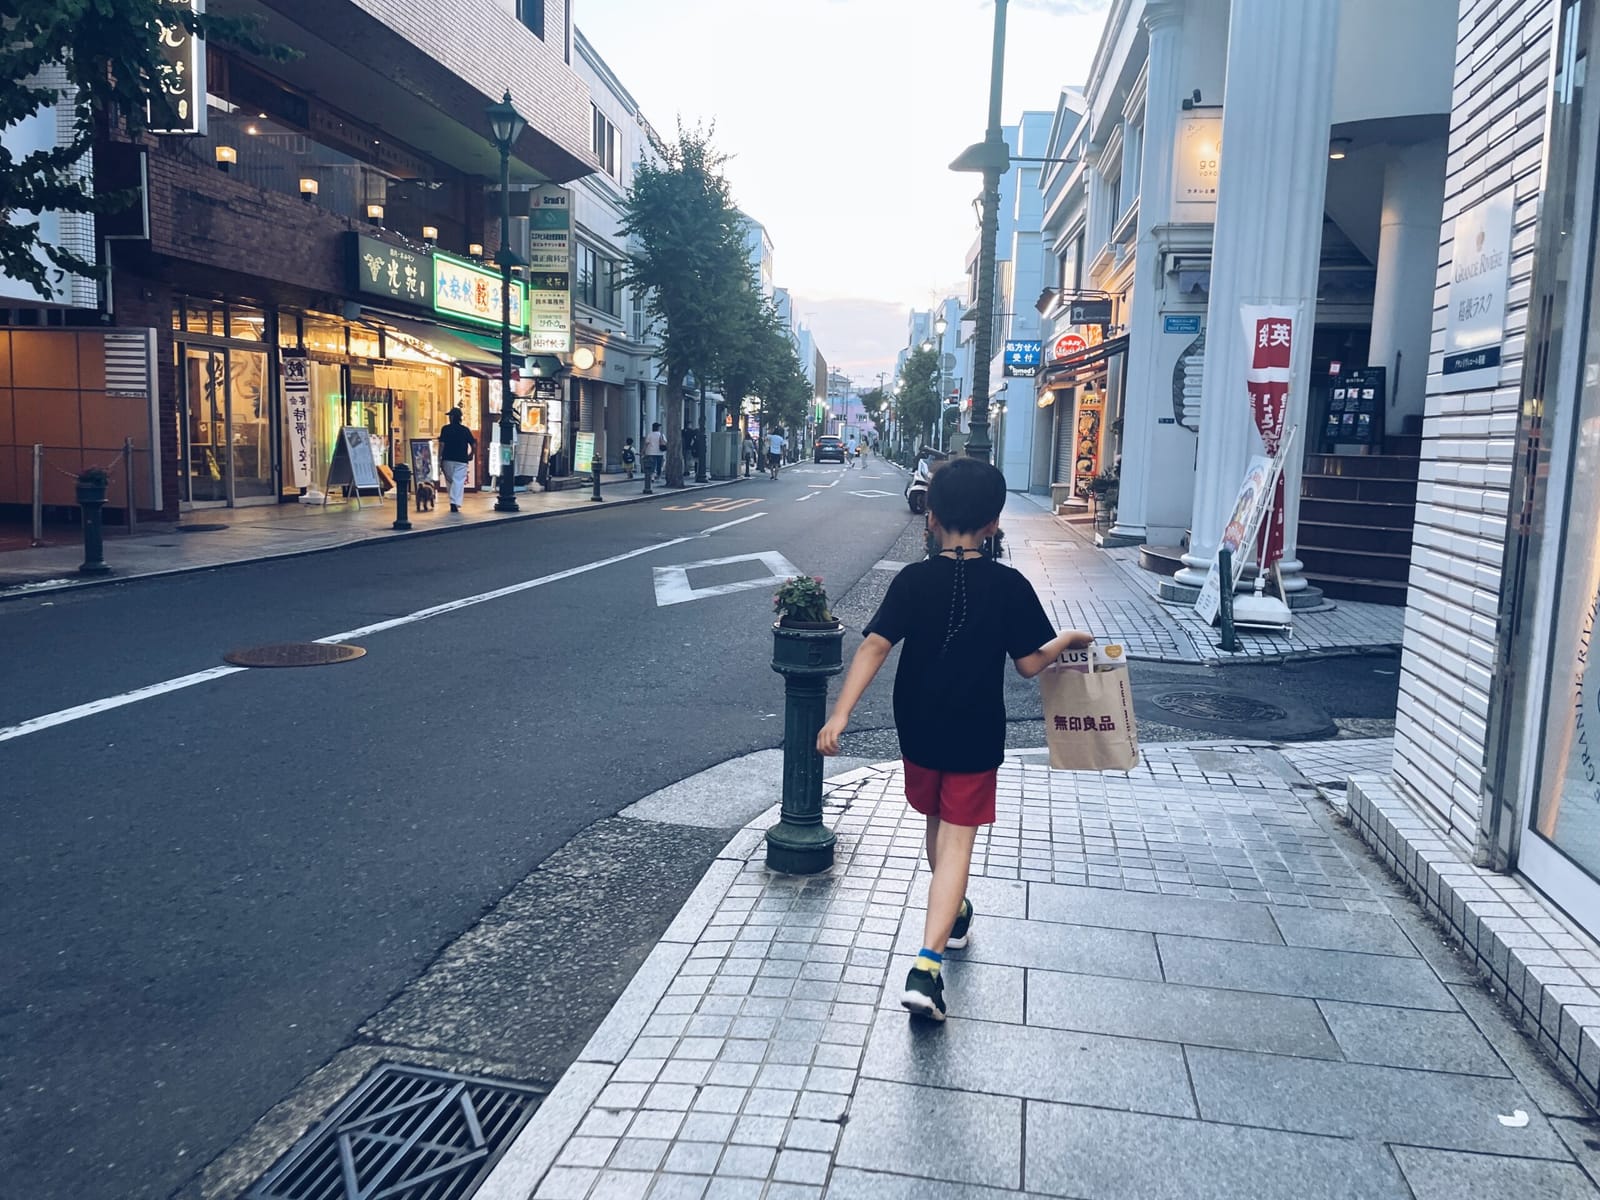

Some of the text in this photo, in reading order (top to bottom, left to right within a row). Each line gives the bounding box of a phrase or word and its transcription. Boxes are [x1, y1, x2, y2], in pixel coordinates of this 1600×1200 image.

[1006, 343, 1041, 352] 処方せん
[1012, 353, 1033, 363] 受付
[1054, 715, 1116, 732] 無印良品
